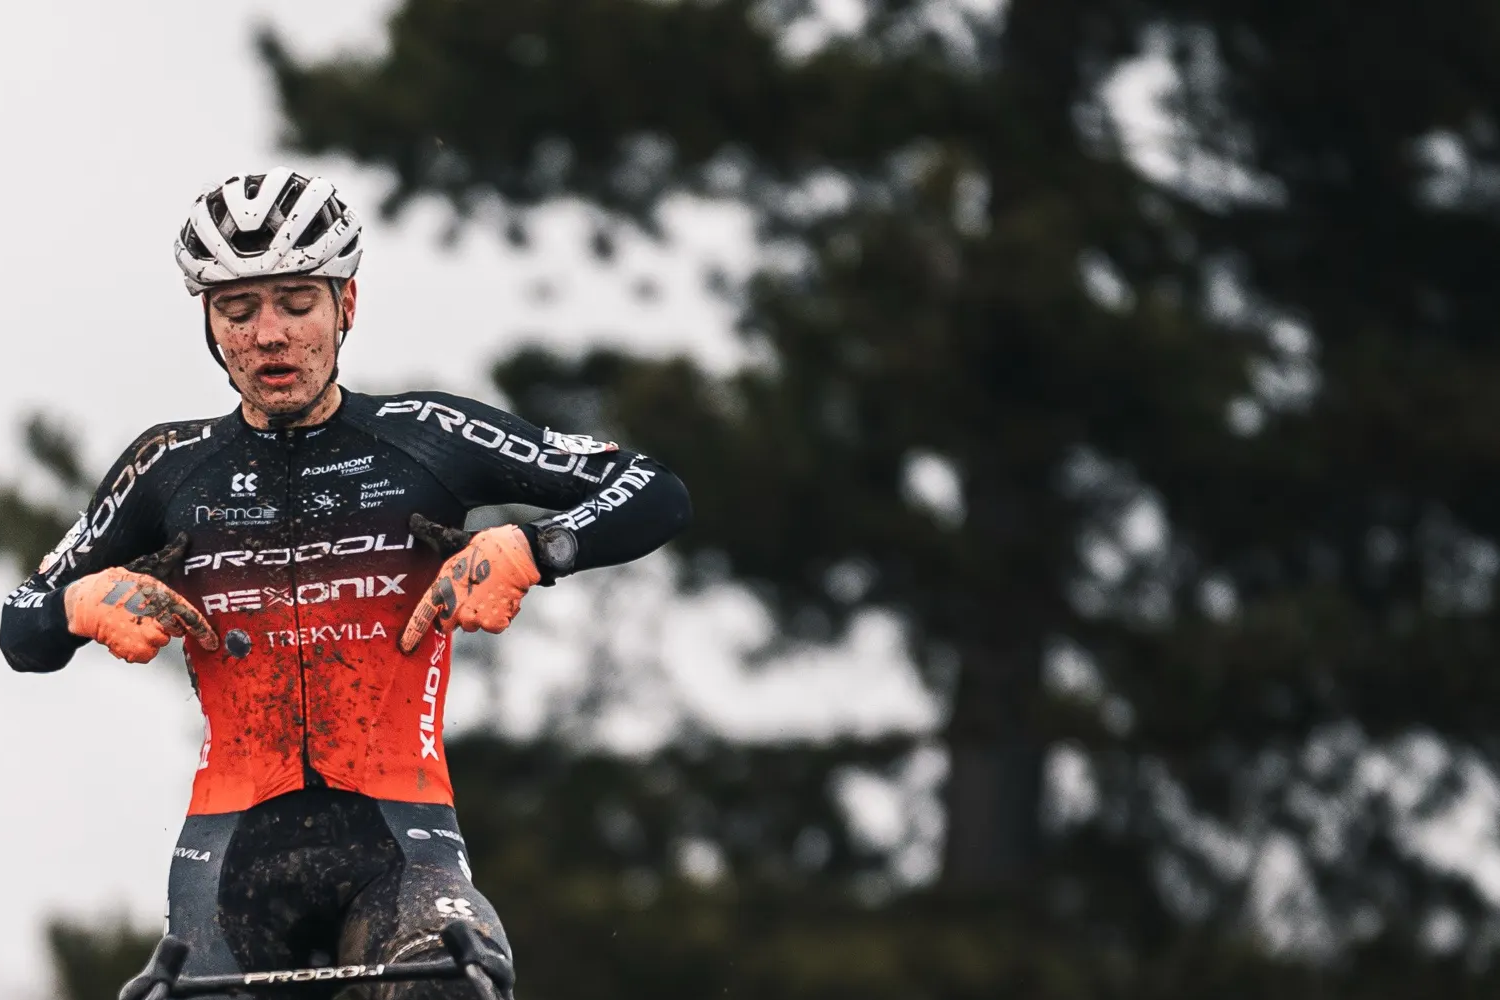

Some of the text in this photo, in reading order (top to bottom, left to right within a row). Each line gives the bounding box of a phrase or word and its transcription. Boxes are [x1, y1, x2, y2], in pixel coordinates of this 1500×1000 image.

[376, 400, 616, 484] PRODOLI
[301, 455, 375, 477] AQUAMONT
[360, 479, 391, 491] South
[360, 487, 405, 500] Bohemia
[184, 533, 414, 576] PRODOLI
[202, 573, 408, 616] REXONIX
[267, 621, 387, 648] TREKVILA
